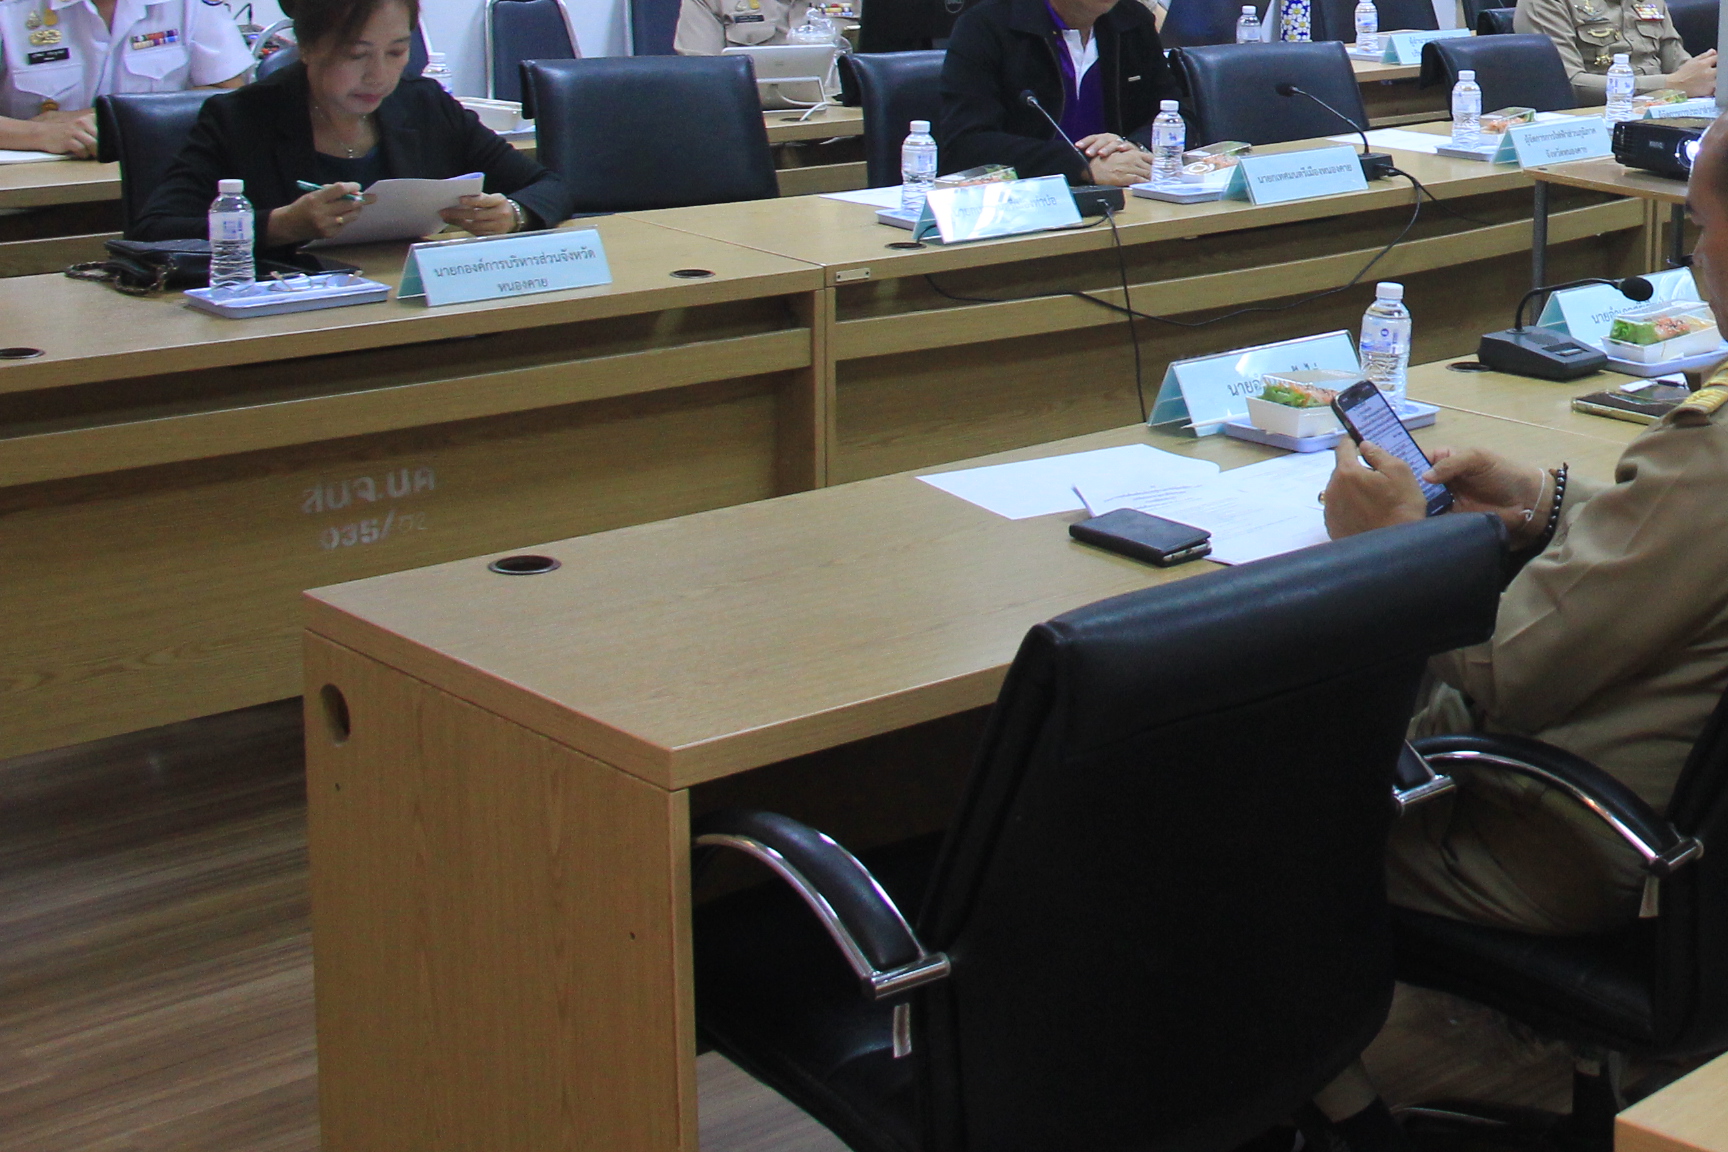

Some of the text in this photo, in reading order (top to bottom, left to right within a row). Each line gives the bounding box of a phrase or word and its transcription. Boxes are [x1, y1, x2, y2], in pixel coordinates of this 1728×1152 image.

[433, 246, 597, 278] นายกองค์การบริหารส่วนจังหวัด
[497, 277, 549, 293] หนองคาย
